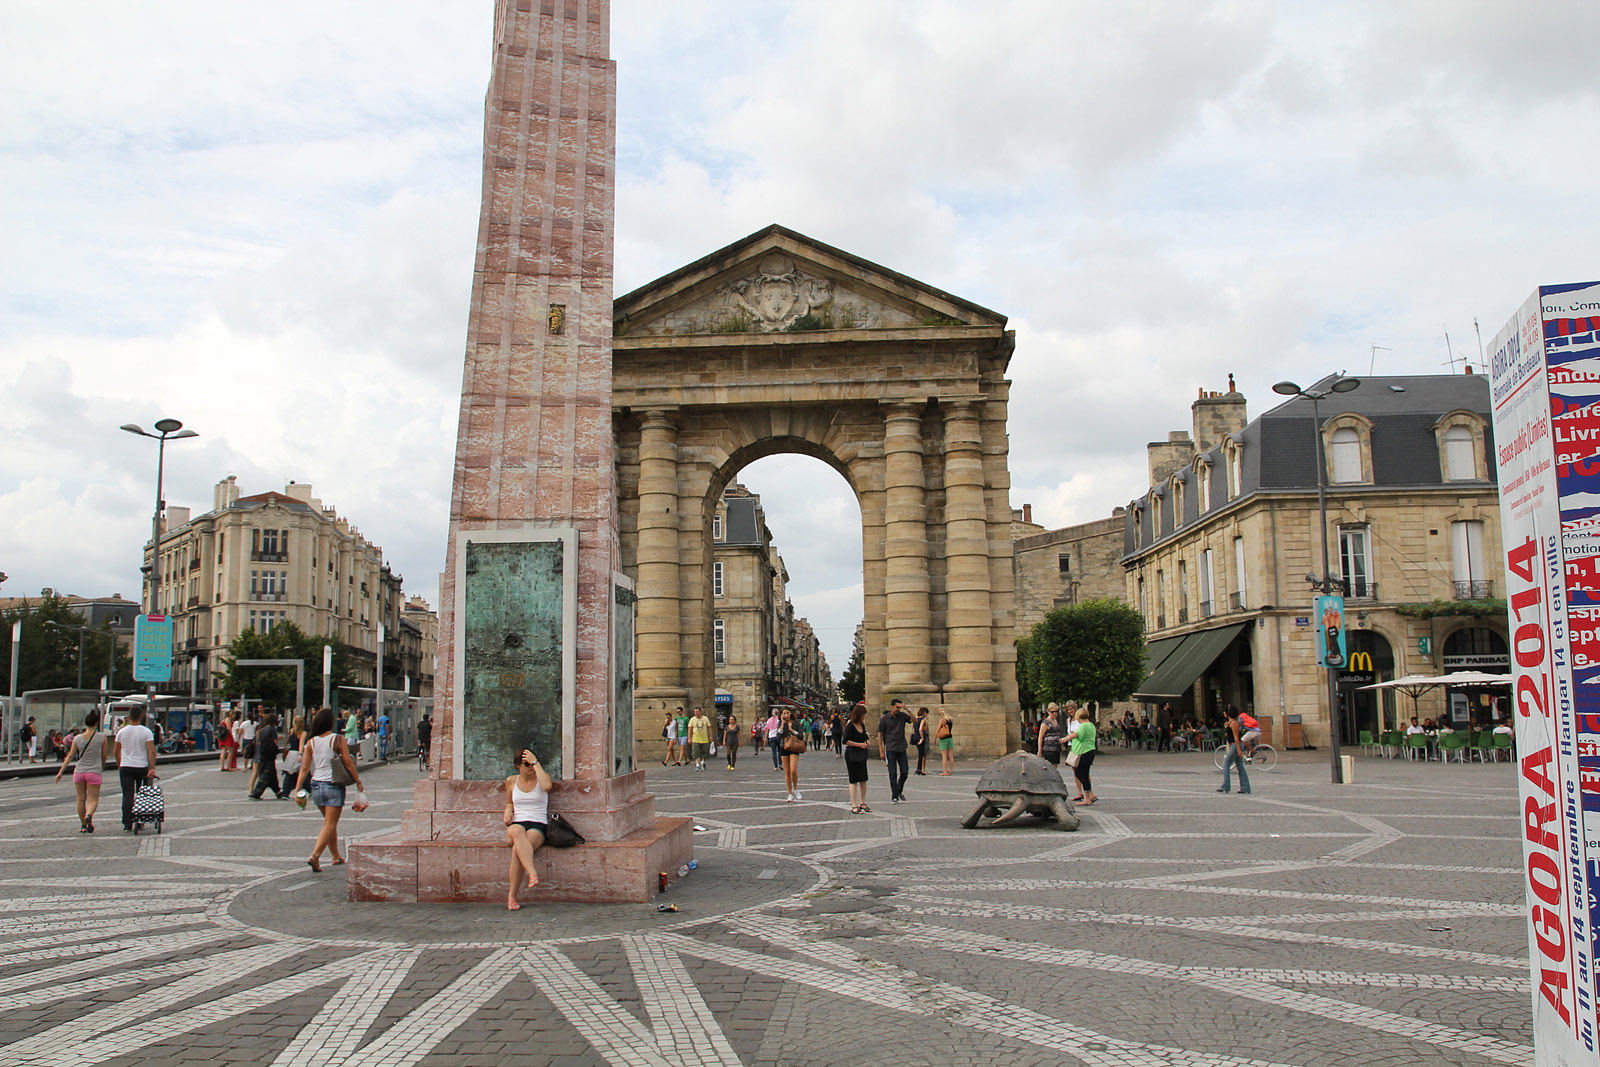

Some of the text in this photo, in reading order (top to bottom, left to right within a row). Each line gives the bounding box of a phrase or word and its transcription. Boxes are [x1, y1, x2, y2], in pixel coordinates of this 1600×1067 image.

[1492, 331, 1520, 383] AGORA 2014
[1494, 376, 1512, 403] Biennale
[1518, 350, 1541, 380] Bordeaux
[1498, 442, 1514, 469] Espace
[1514, 428, 1527, 461] public
[1547, 535, 1559, 579] ville
[1553, 585, 1561, 605] en
[1507, 535, 1550, 718] 2014
[1553, 620, 1564, 640] et
[1444, 656, 1508, 665] BNP PARIBAS
[1555, 647, 1566, 670] 14
[1559, 677, 1572, 756] Hangar
[1565, 779, 1584, 909] septembre
[1522, 745, 1571, 1029] AGORA
[1573, 916, 1585, 942] 14
[1578, 951, 1588, 984] au
[1578, 986, 1590, 1011] 11
[1581, 1019, 1593, 1052] du
